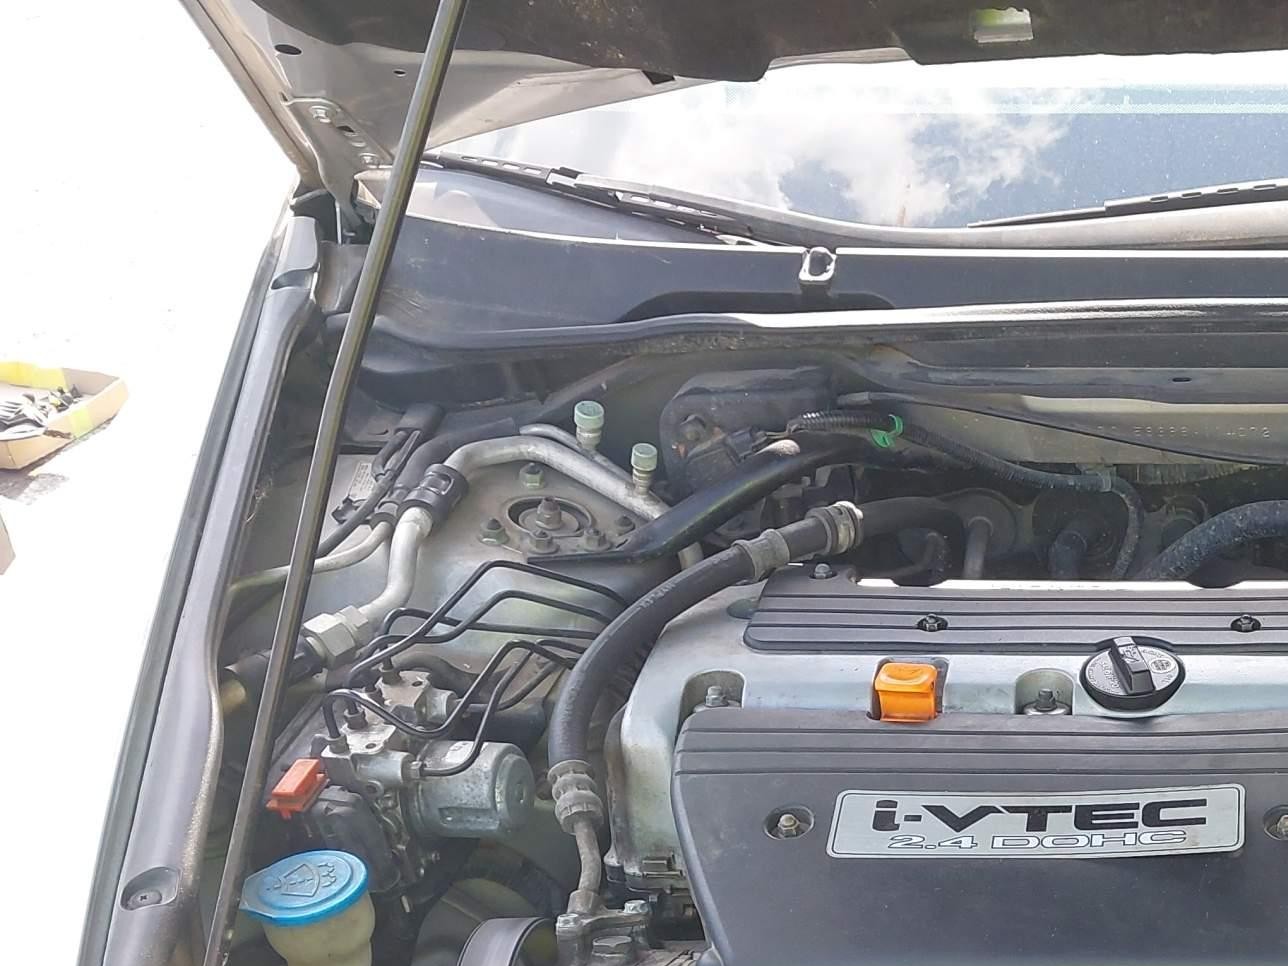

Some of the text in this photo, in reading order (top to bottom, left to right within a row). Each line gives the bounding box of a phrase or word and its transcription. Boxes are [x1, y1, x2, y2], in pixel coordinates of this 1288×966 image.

[872, 798, 1208, 833] i-VTEC
[888, 830, 1187, 850] 2.4 DOHC
